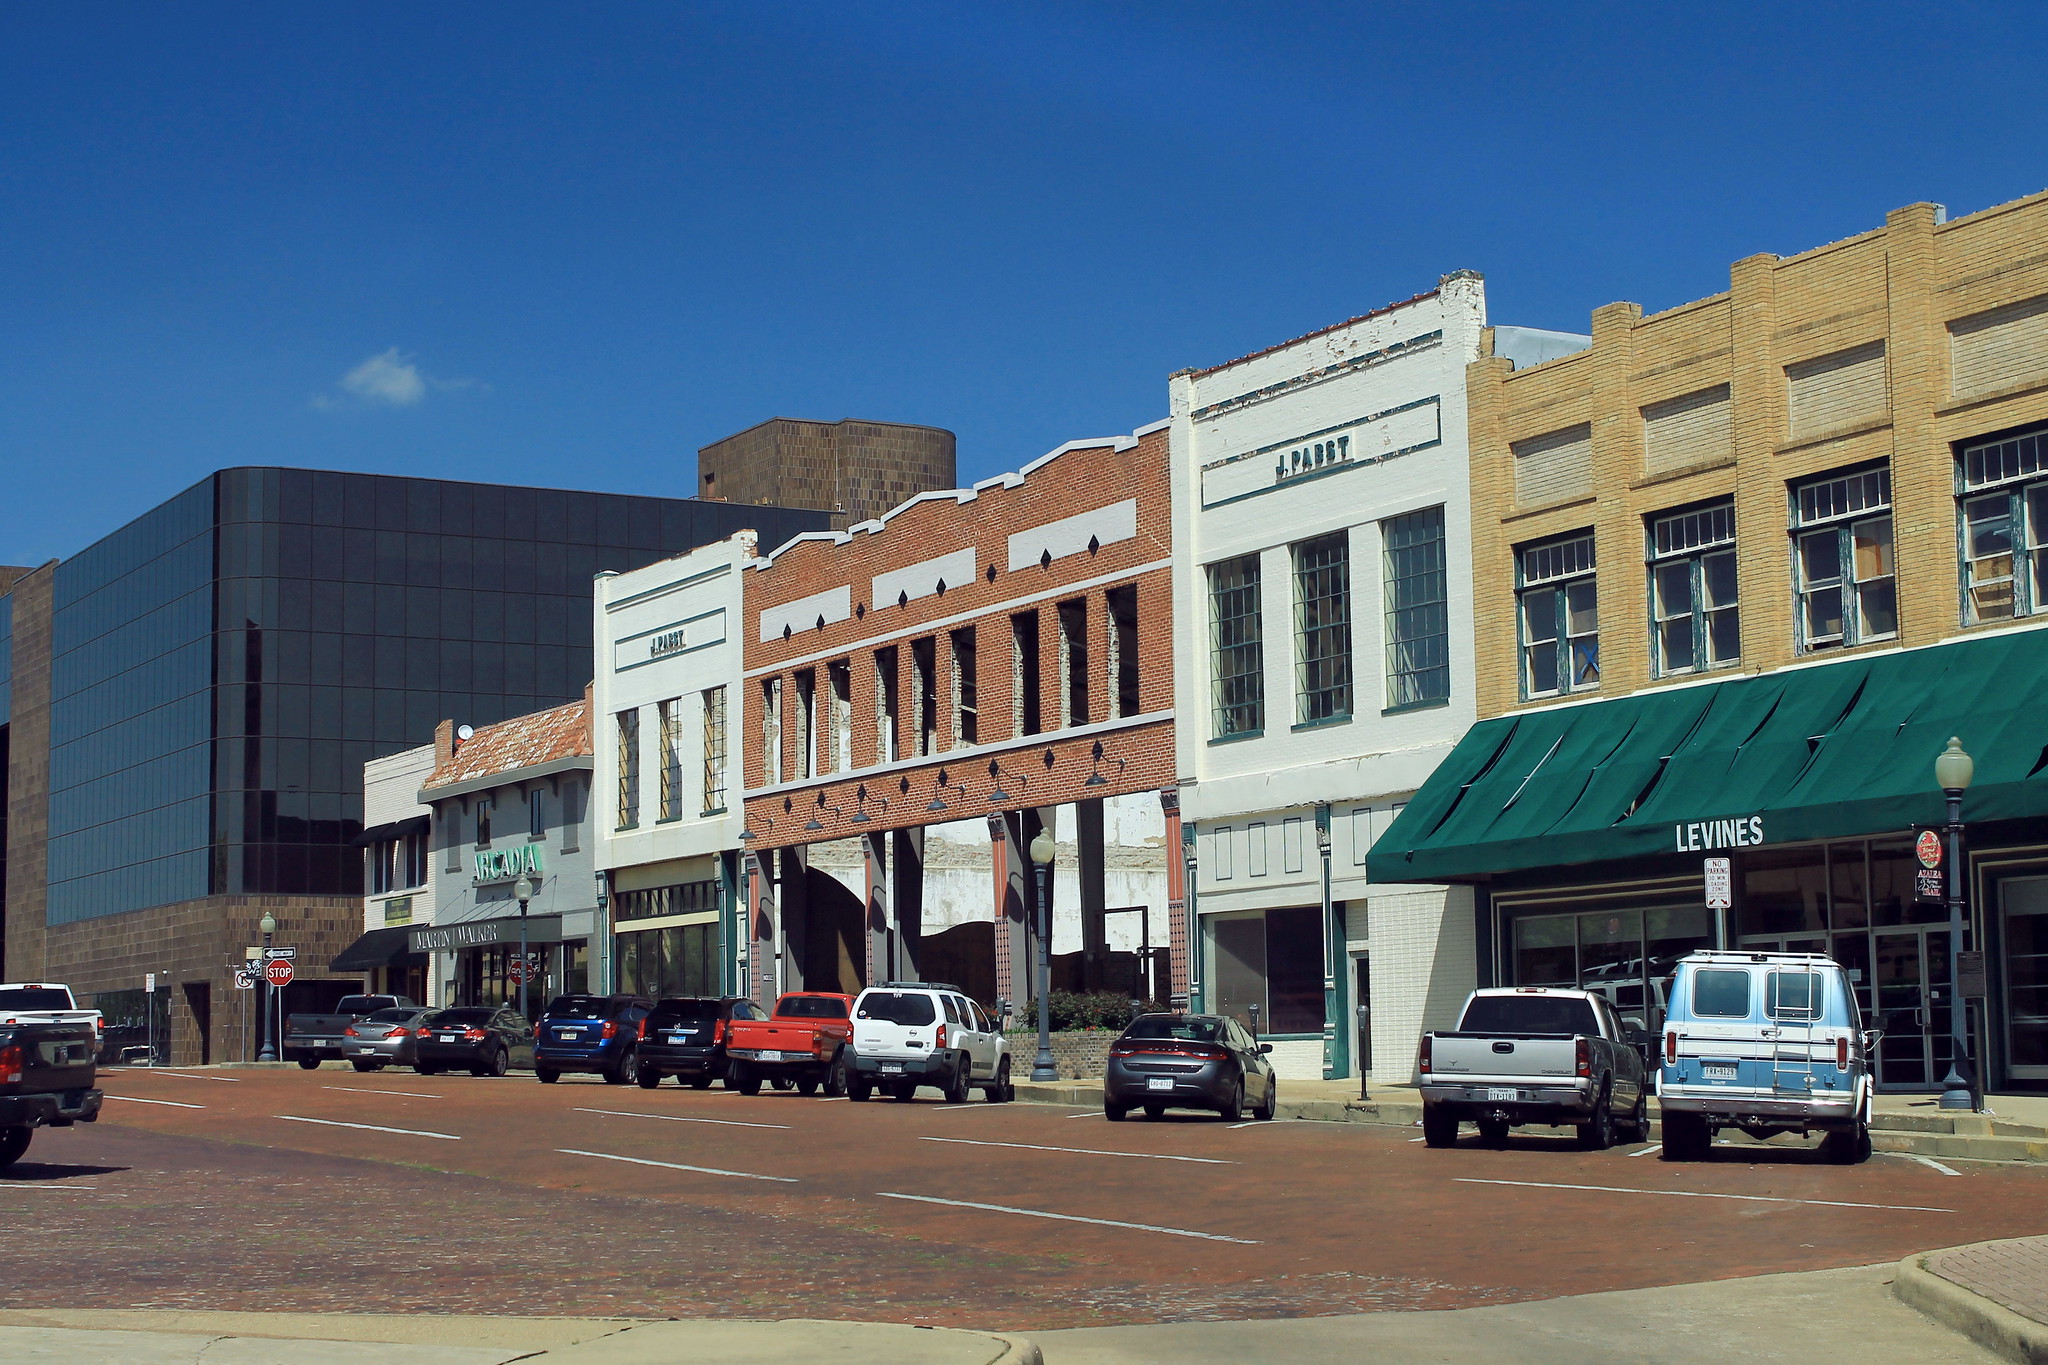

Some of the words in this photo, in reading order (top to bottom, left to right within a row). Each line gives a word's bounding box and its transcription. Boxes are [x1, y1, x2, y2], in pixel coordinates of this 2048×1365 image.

[1676, 816, 1763, 852] LEVINES
[474, 845, 541, 881] ARCADIA
[1918, 870, 1942, 878] AZALEA
[416, 930, 450, 949] MARTIN
[458, 924, 497, 943] WALKER
[268, 967, 291, 978] STOP
